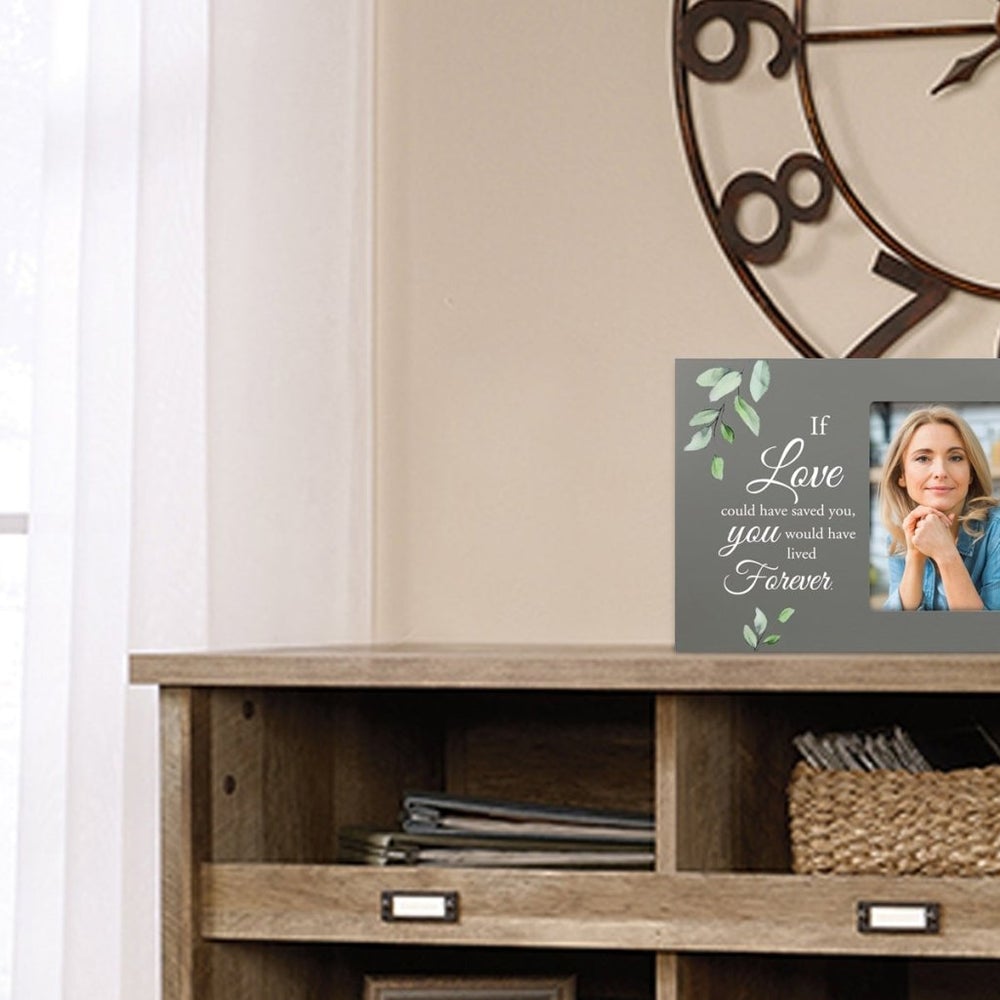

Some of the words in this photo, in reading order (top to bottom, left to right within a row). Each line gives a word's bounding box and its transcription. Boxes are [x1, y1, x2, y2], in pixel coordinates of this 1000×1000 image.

[719, 152, 833, 265] 8
[846, 250, 951, 359] 7
[810, 415, 831, 436] If
[746, 437, 845, 505] Love
[720, 504, 756, 517] could
[760, 504, 788, 517] have
[791, 504, 825, 517] saved
[828, 507, 856, 520] you,
[718, 525, 782, 557] you
[785, 527, 824, 540] would
[828, 527, 857, 540] have
[787, 547, 817, 560] lived
